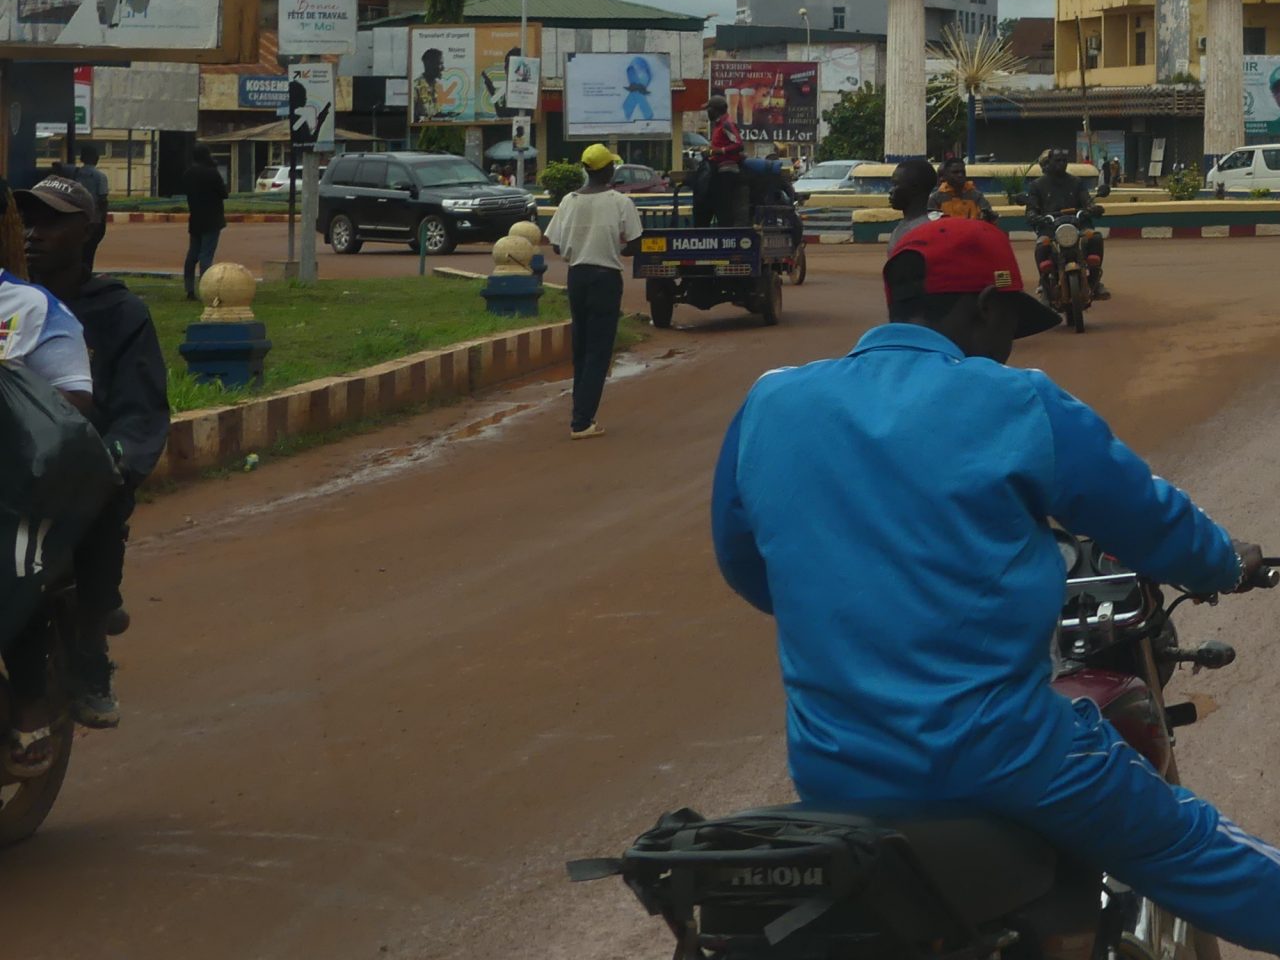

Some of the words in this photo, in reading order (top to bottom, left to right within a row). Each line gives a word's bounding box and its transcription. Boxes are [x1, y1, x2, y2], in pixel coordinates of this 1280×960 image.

[287, 10, 304, 20] FÊTE
[306, 11, 316, 20] DE
[318, 11, 348, 20] TRAVAIL
